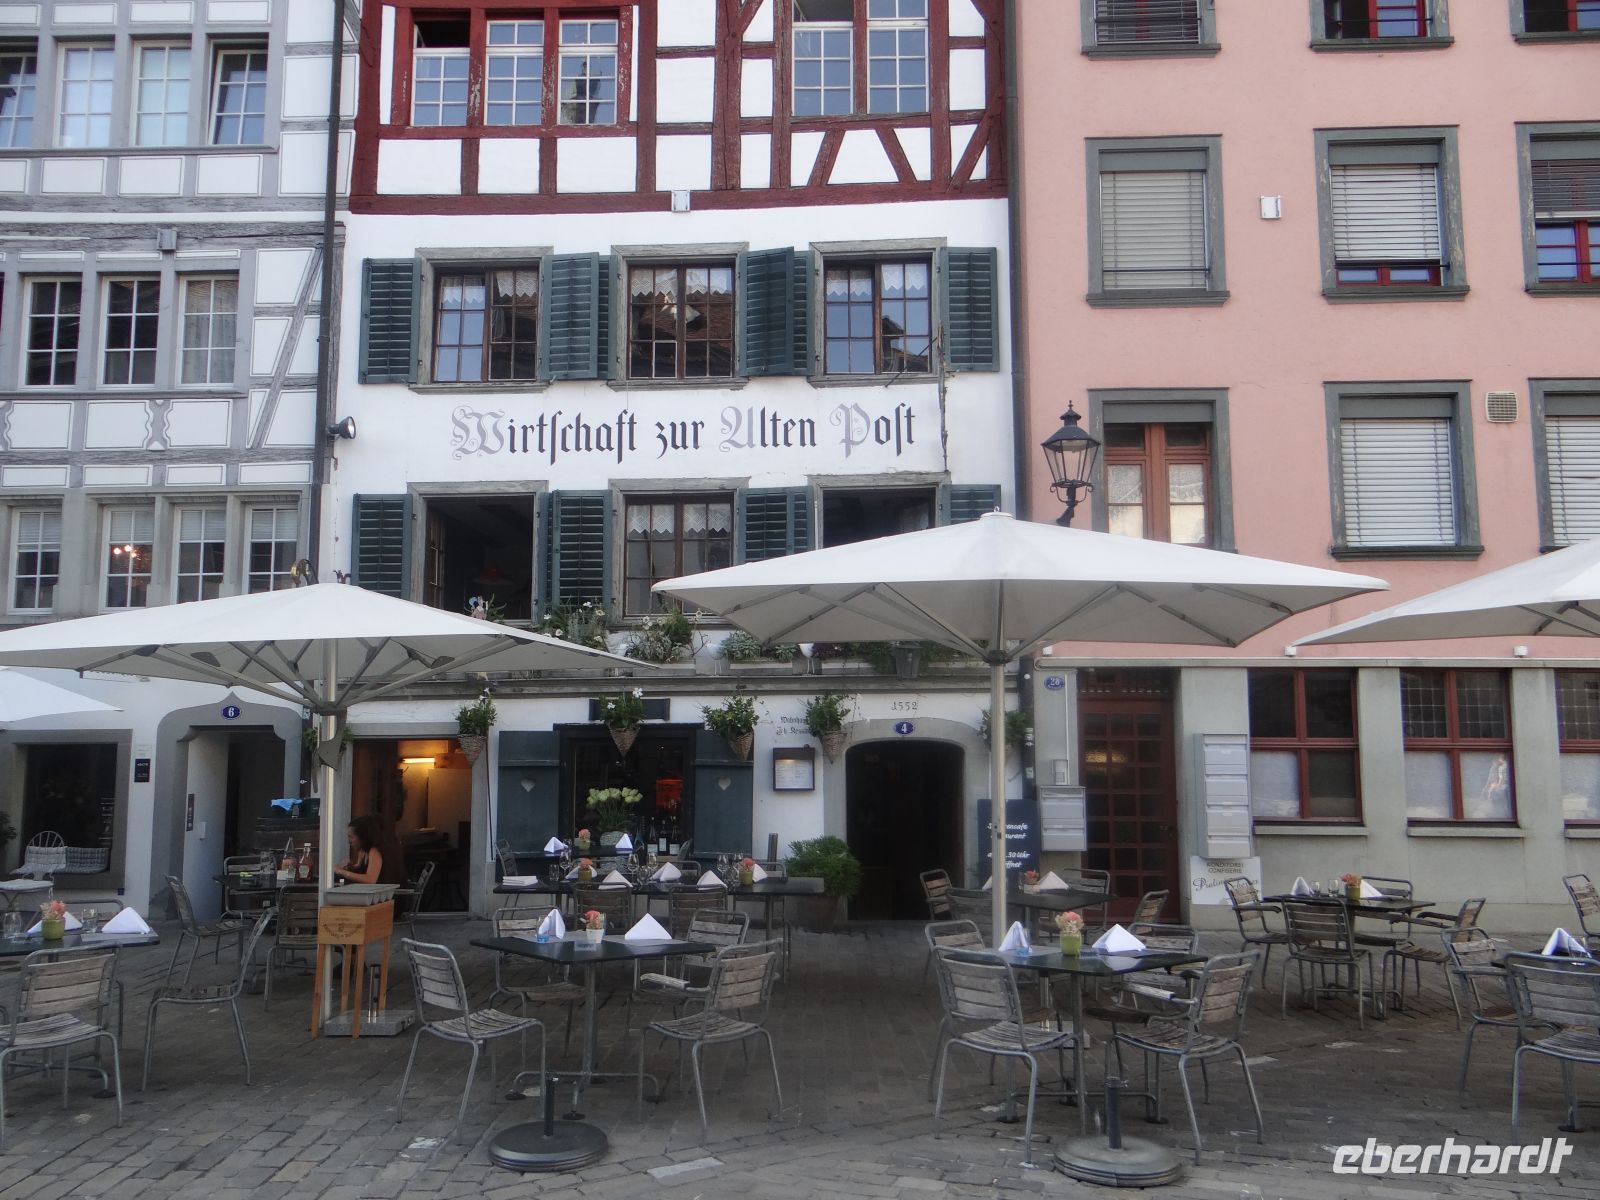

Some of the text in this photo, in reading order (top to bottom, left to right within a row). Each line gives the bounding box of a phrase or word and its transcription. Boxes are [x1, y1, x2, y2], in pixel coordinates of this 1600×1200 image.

[655, 419, 705, 459] zur
[719, 405, 817, 452] Alten
[891, 701, 918, 711] 1552
[228, 707, 235, 718] 6
[901, 723, 908, 734] 4
